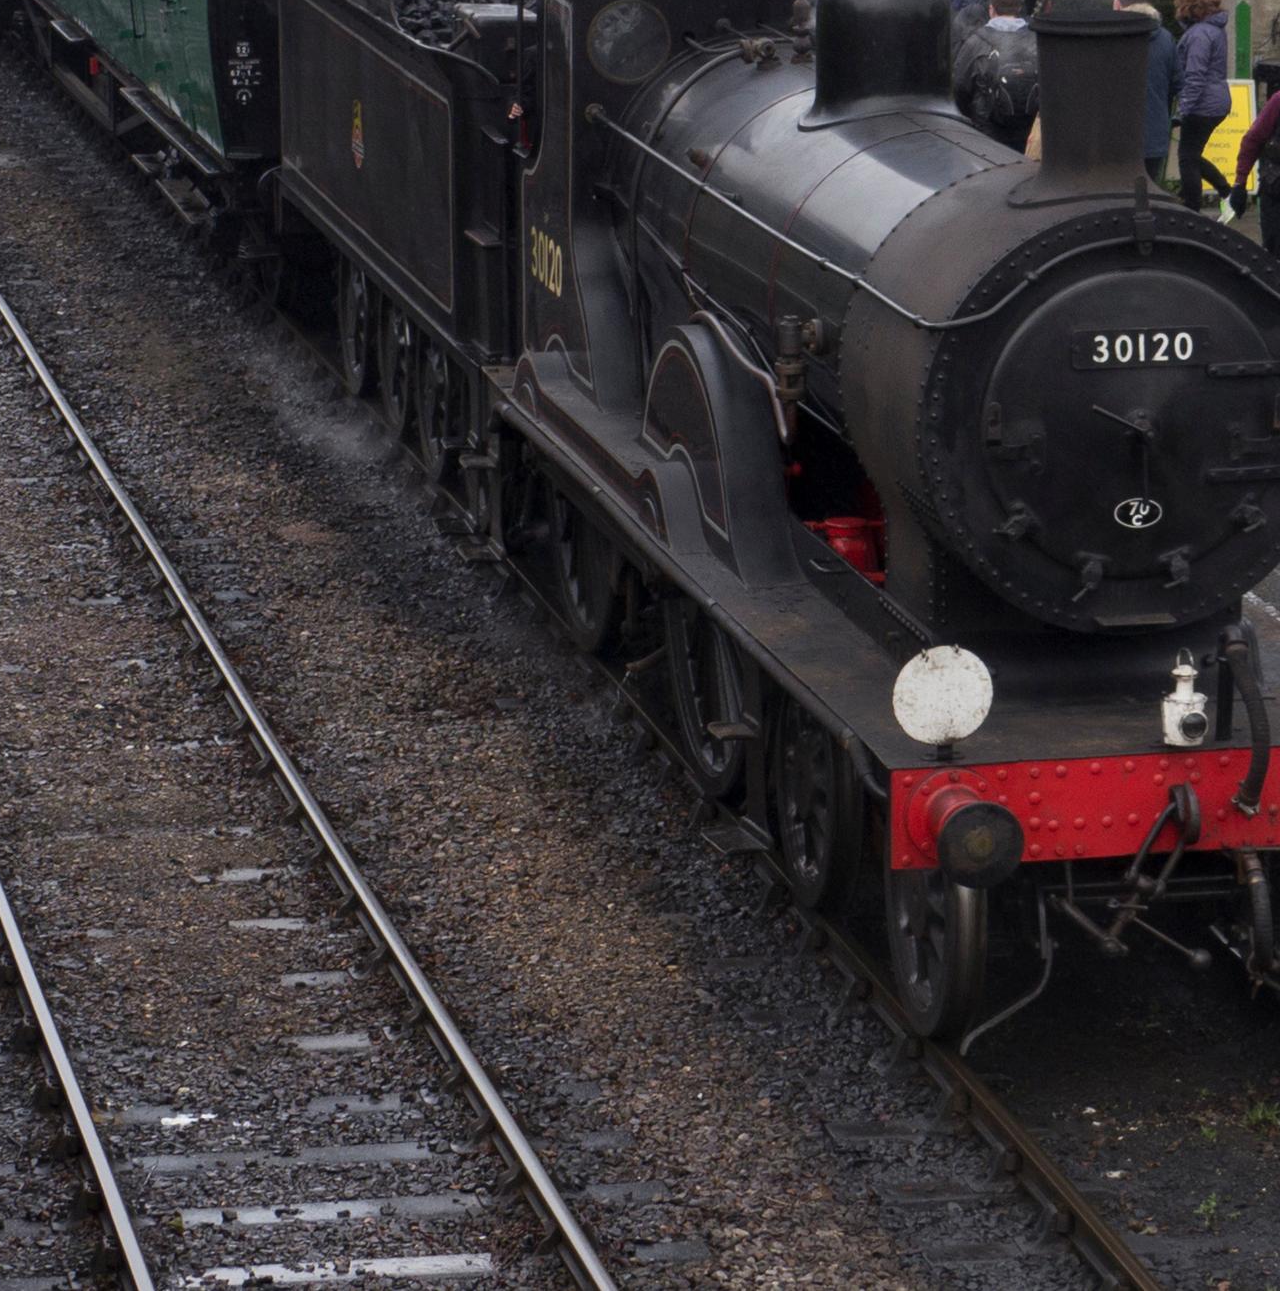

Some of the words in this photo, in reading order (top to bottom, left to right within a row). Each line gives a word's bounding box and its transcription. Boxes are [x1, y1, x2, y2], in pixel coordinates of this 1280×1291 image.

[531, 225, 563, 298] 30120
[1092, 332, 1193, 363] 30120
[1132, 514, 1143, 526] C
